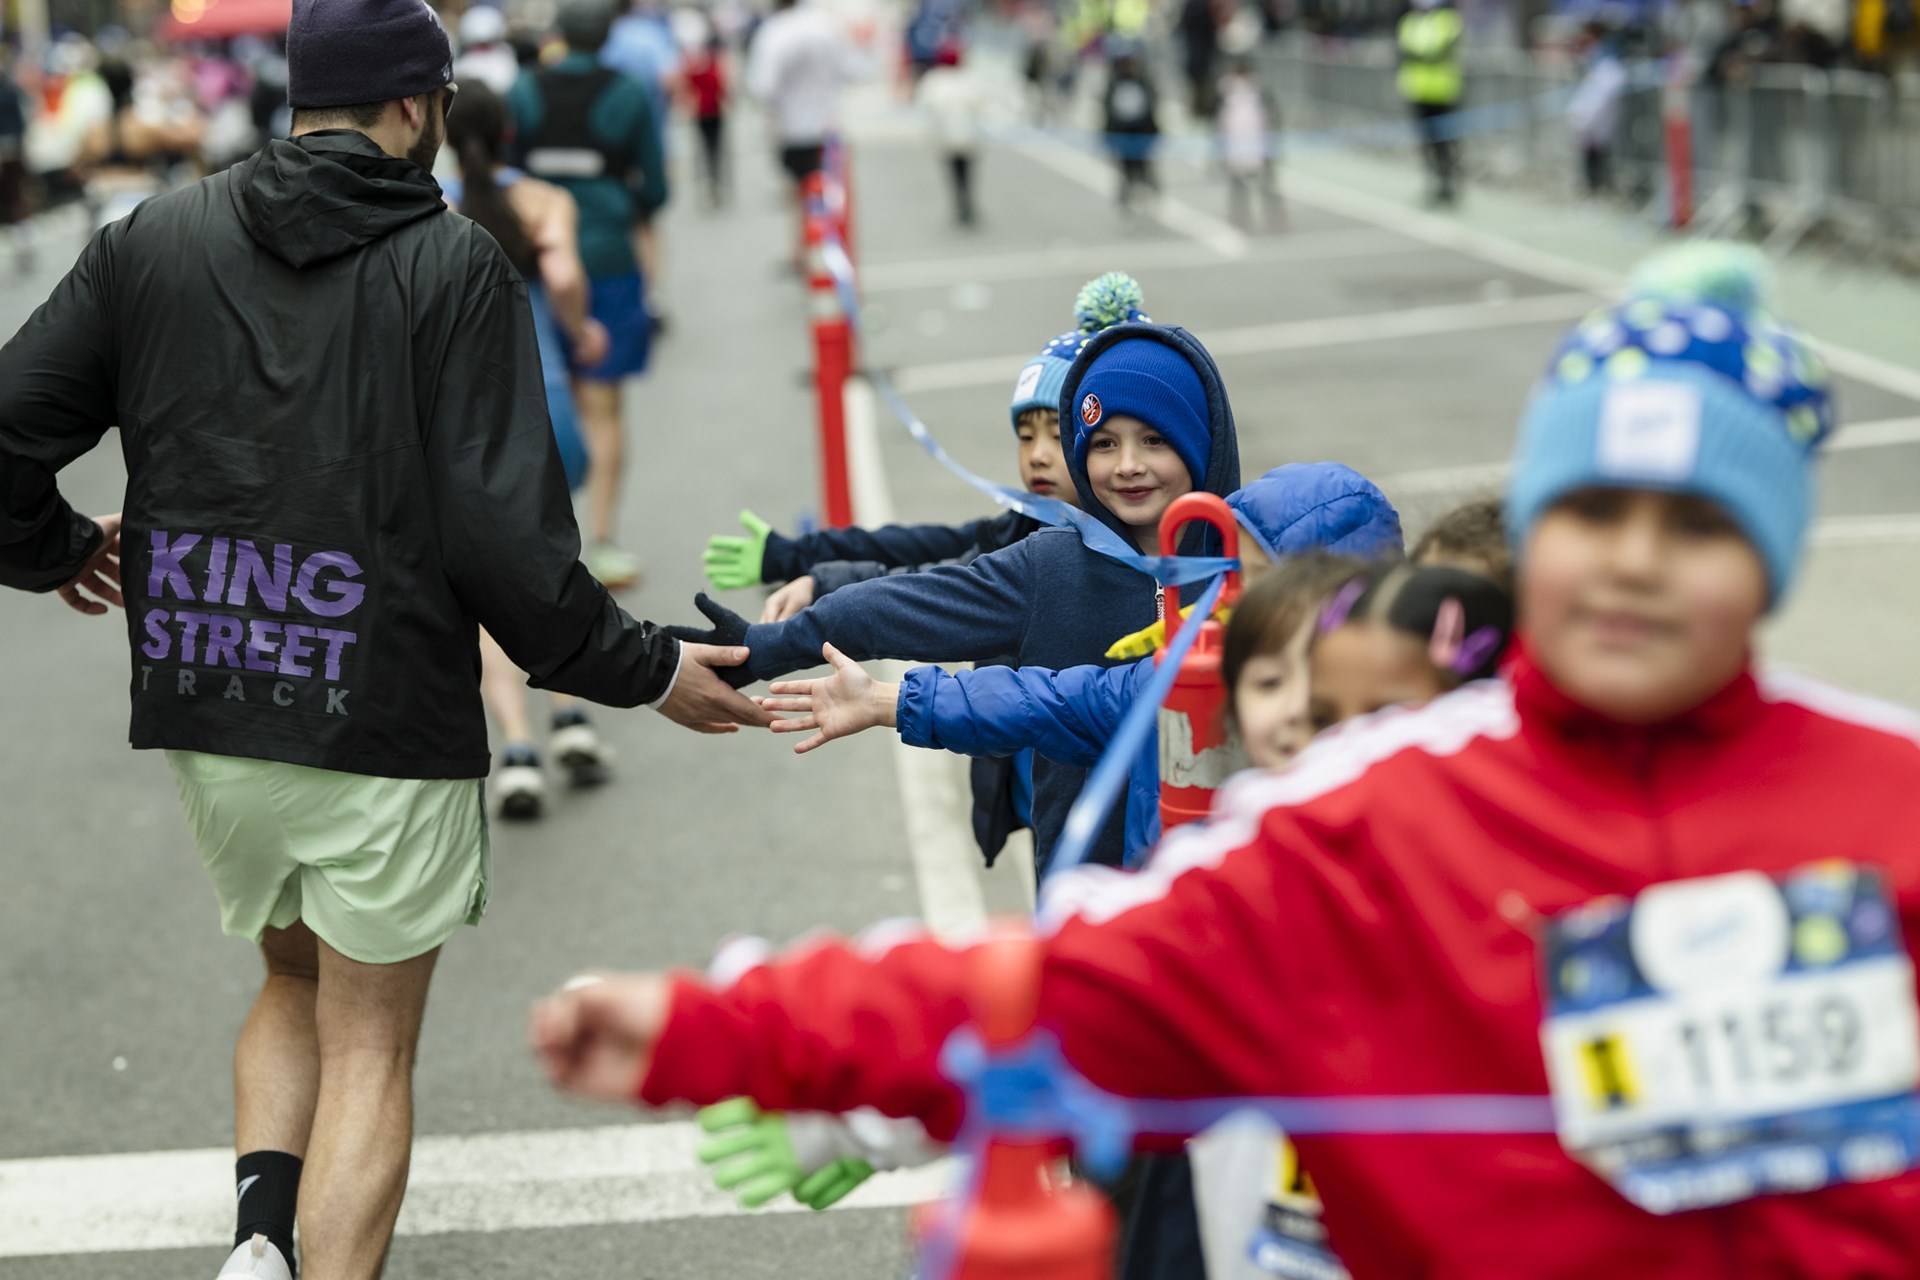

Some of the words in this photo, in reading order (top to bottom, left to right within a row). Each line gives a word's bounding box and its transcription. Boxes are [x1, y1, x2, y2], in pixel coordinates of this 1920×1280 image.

[147, 530, 366, 618] KING
[141, 608, 357, 681] STREET
[141, 665, 350, 716] TRACK
[1679, 997, 1863, 1090] 1159
